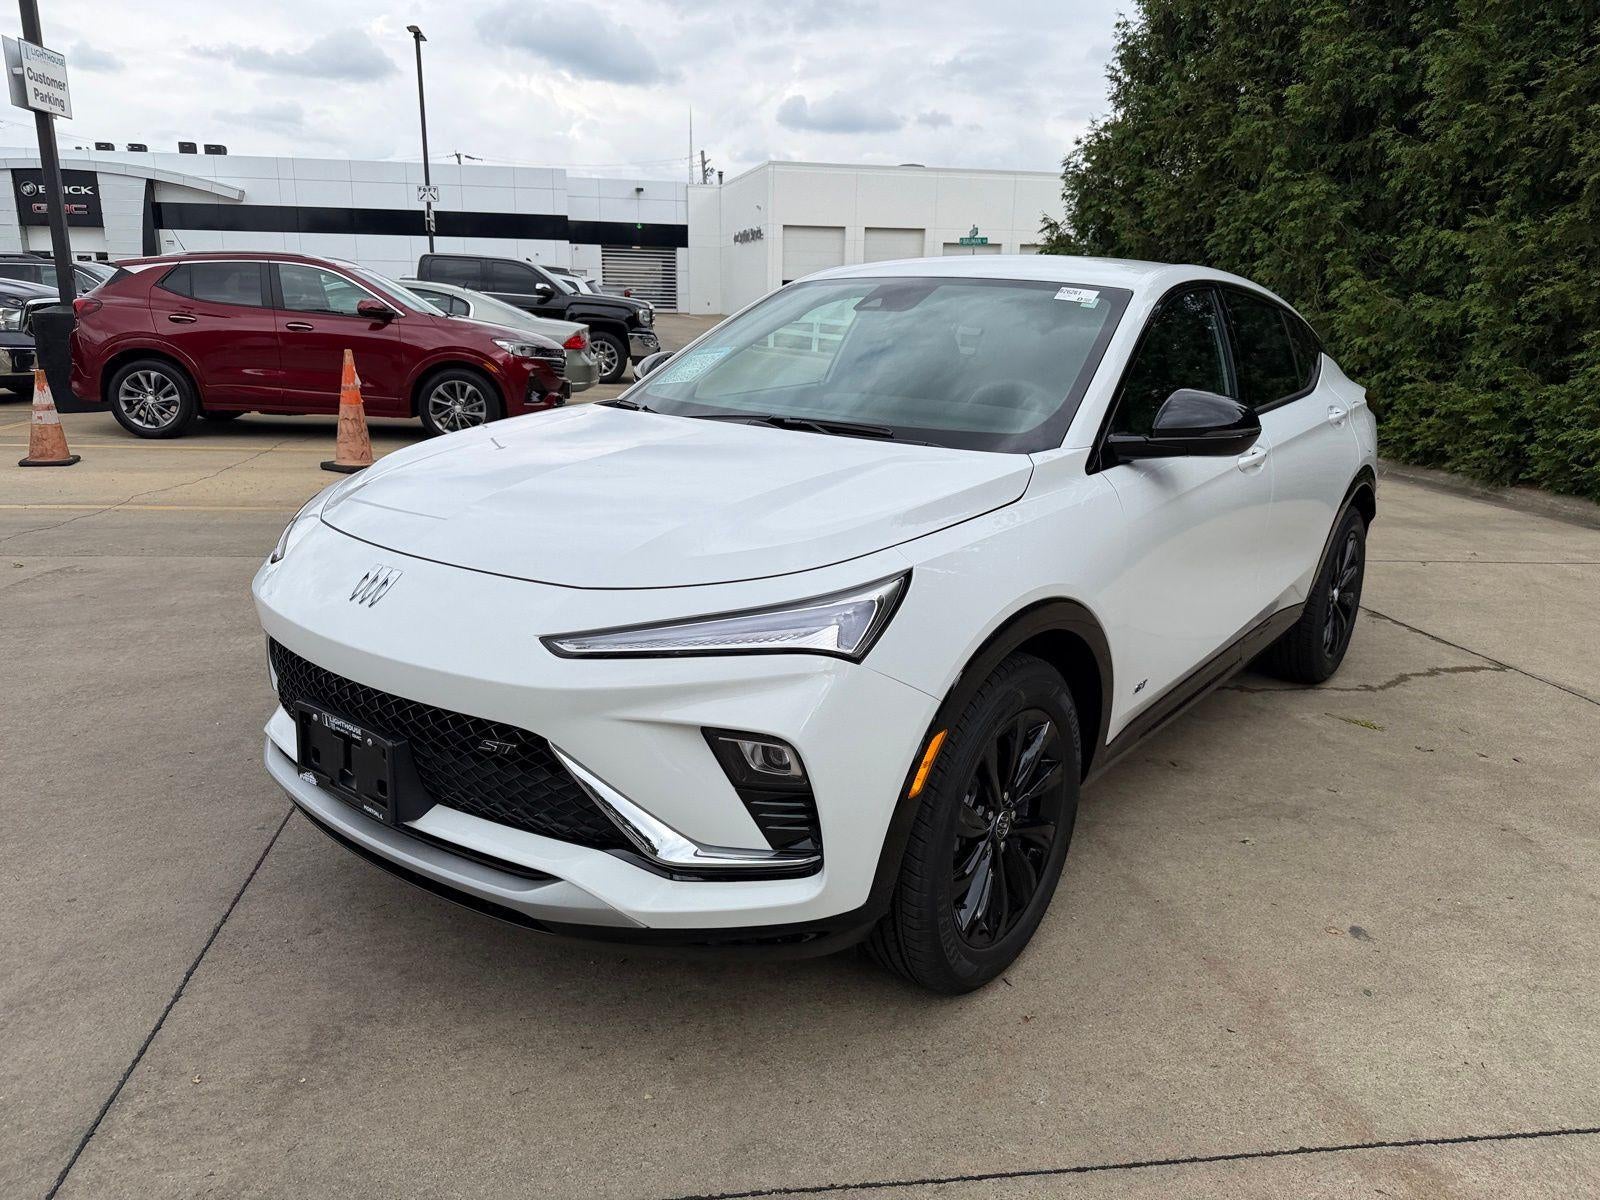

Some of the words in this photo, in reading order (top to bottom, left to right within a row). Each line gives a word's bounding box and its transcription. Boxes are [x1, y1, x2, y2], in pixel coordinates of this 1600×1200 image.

[31, 47, 65, 67] LIGHTHOUSE
[26, 66, 66, 91] Customer
[33, 87, 65, 112] Parking
[38, 184, 94, 195] BICK
[329, 714, 362, 736] LIGHTHOUSE
